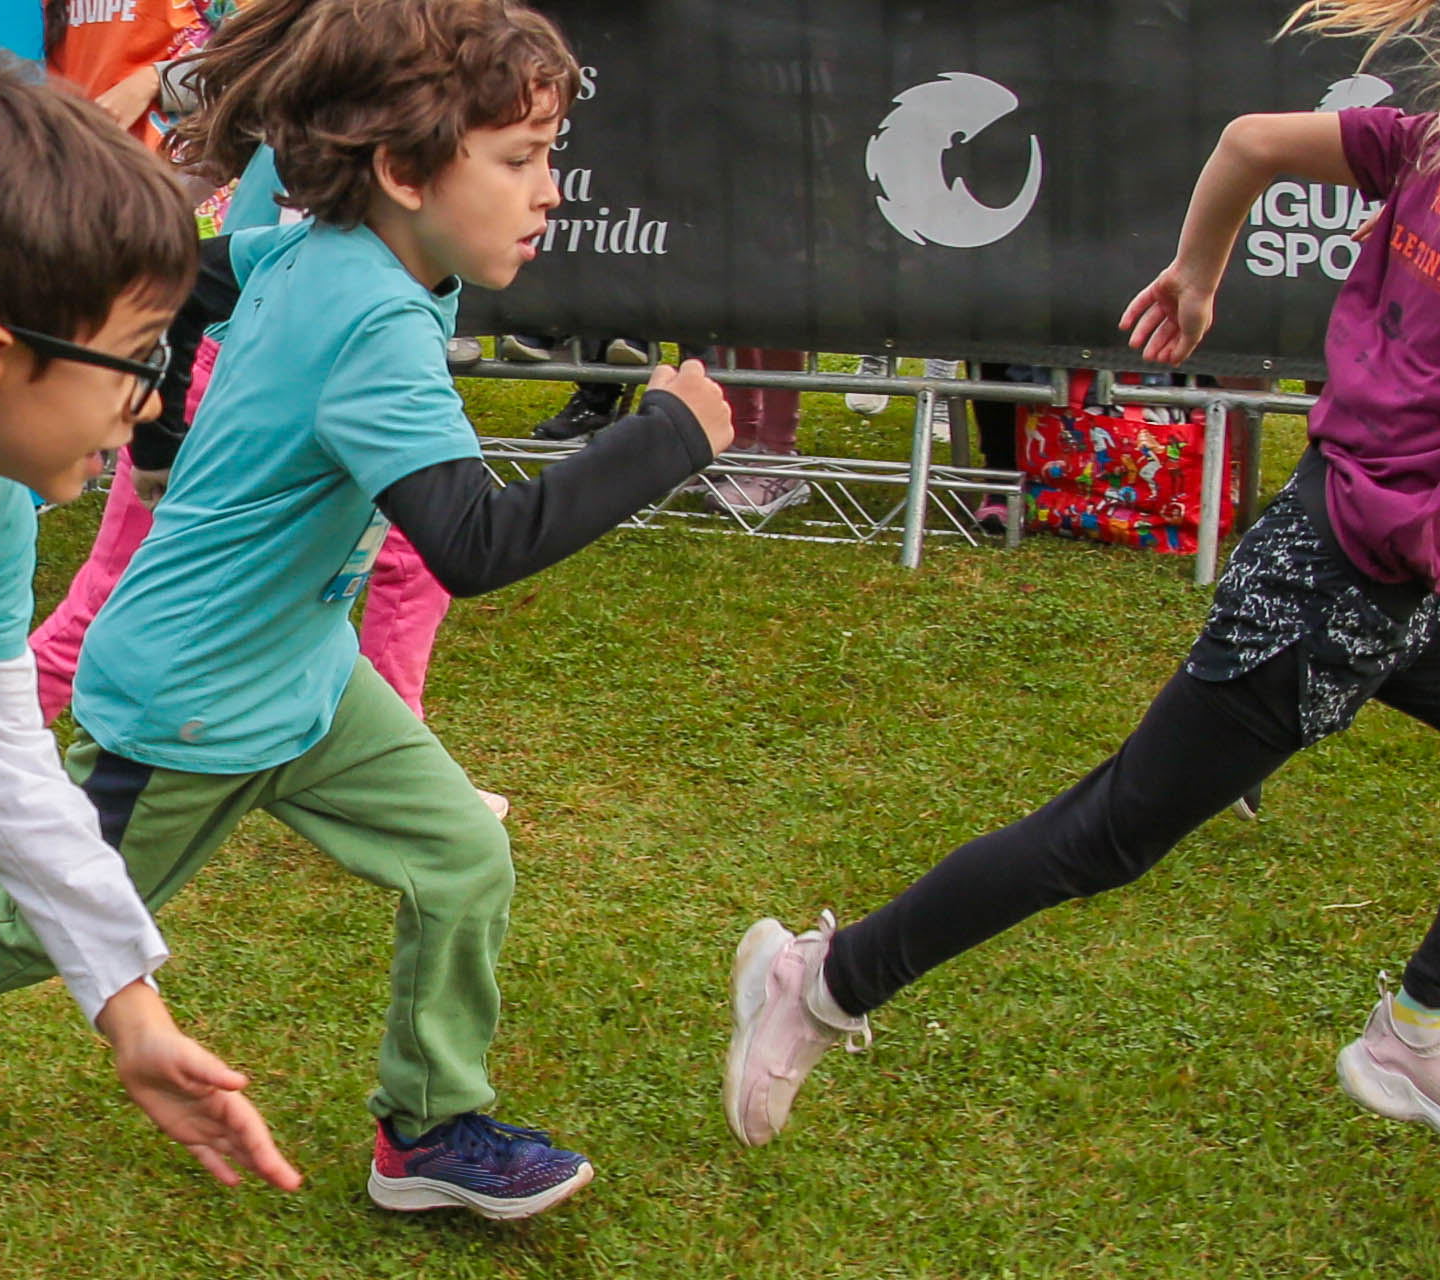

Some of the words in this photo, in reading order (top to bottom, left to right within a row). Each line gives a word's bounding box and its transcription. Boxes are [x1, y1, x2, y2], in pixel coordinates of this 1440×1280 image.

[1249, 180, 1386, 230] IGUA
[531, 207, 669, 255] rrida
[1245, 230, 1362, 281] SPO
